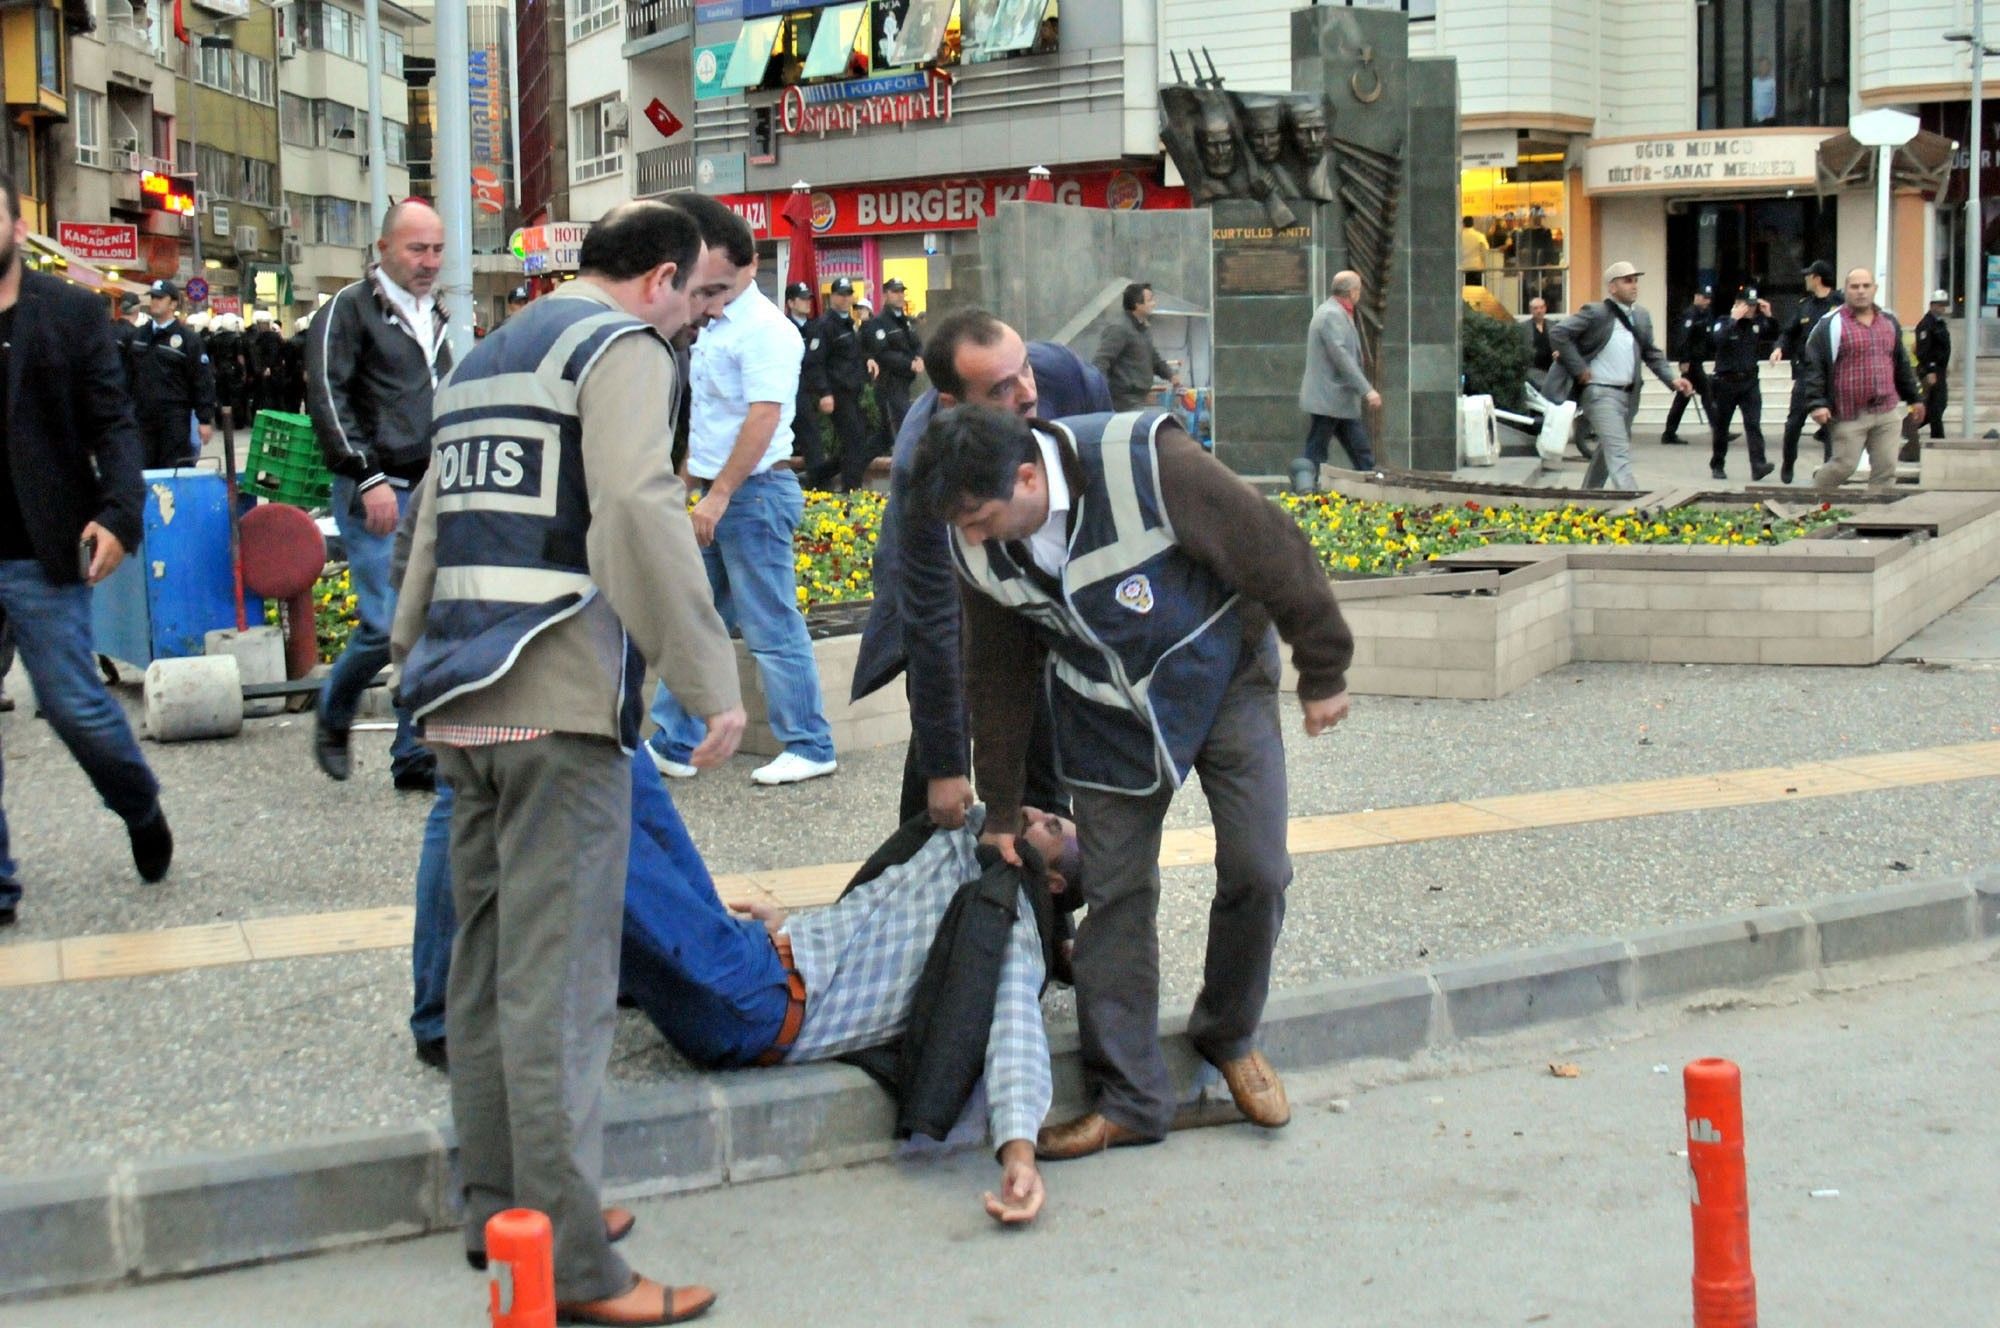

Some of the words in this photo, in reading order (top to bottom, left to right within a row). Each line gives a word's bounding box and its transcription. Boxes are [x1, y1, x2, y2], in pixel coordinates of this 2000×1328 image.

[849, 76, 919, 95] KUAFÖR
[1686, 139, 1754, 157] MUMCU
[858, 187, 986, 226] BURGER
[995, 180, 1081, 207] KG
[63, 229, 131, 247] KARADENİZ
[555, 228, 589, 242] HOTE
[91, 248, 132, 258] SALONU
